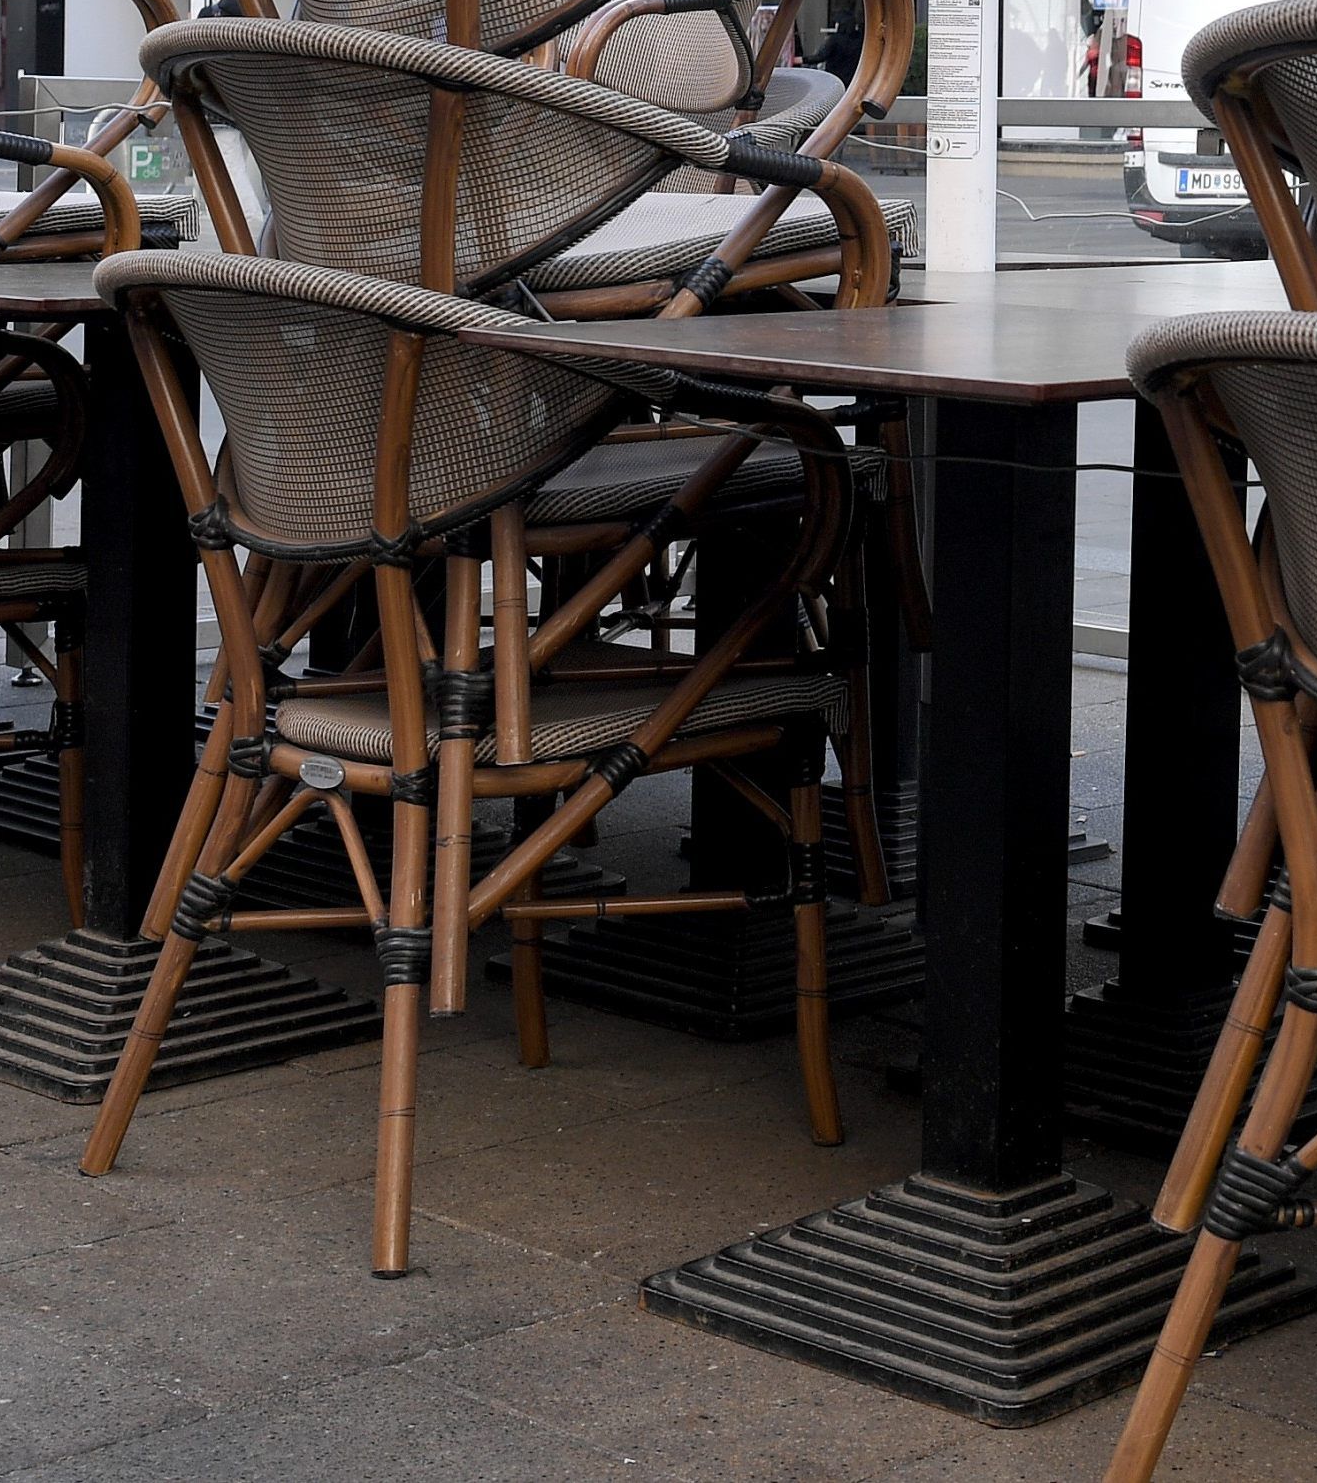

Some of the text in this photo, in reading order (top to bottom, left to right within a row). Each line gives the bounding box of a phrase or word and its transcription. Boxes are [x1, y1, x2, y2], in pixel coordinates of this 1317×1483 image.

[131, 145, 153, 178] P
[1192, 173, 1211, 189] MD
[1223, 173, 1244, 189] 99
